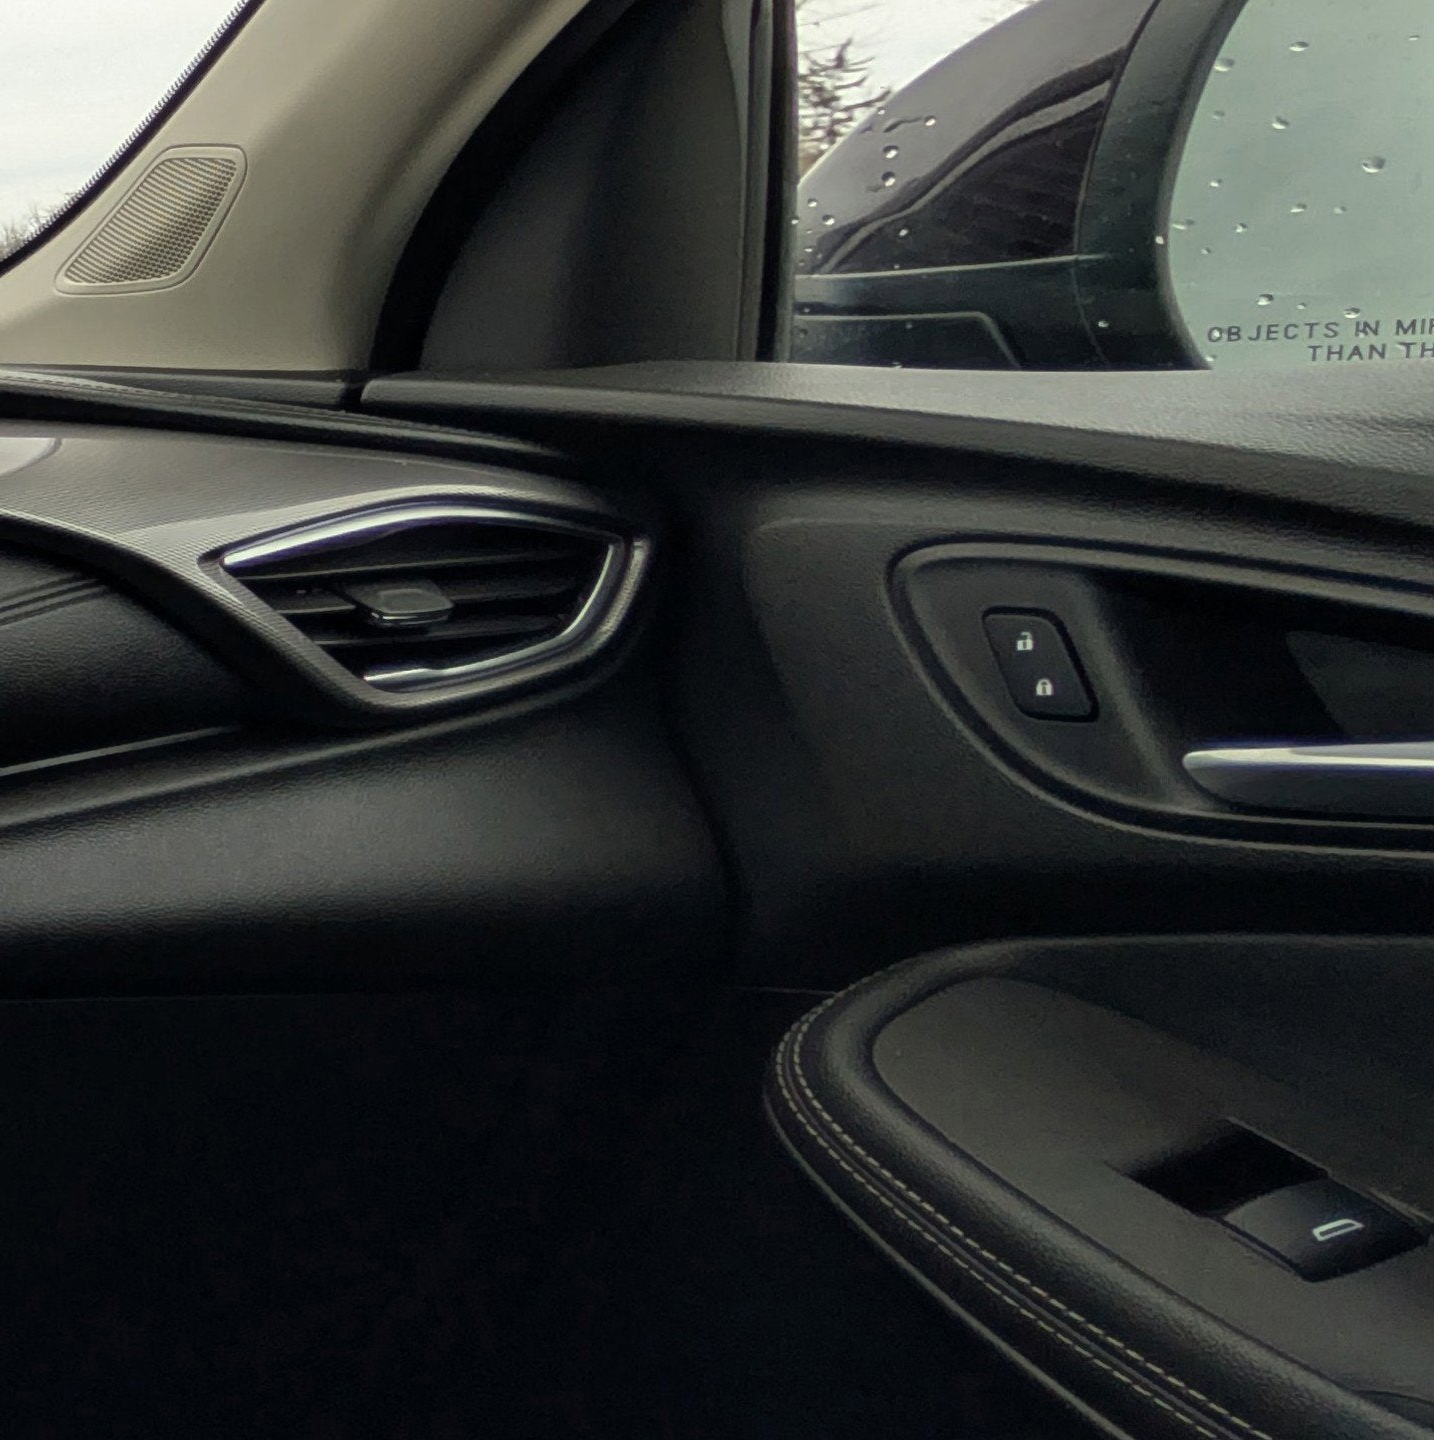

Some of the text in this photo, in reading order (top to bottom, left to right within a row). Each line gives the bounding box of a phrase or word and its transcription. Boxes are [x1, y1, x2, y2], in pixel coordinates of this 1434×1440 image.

[1207, 322, 1339, 343] OBJECTS
[1355, 320, 1380, 337] IN
[1308, 343, 1387, 362] THAN
